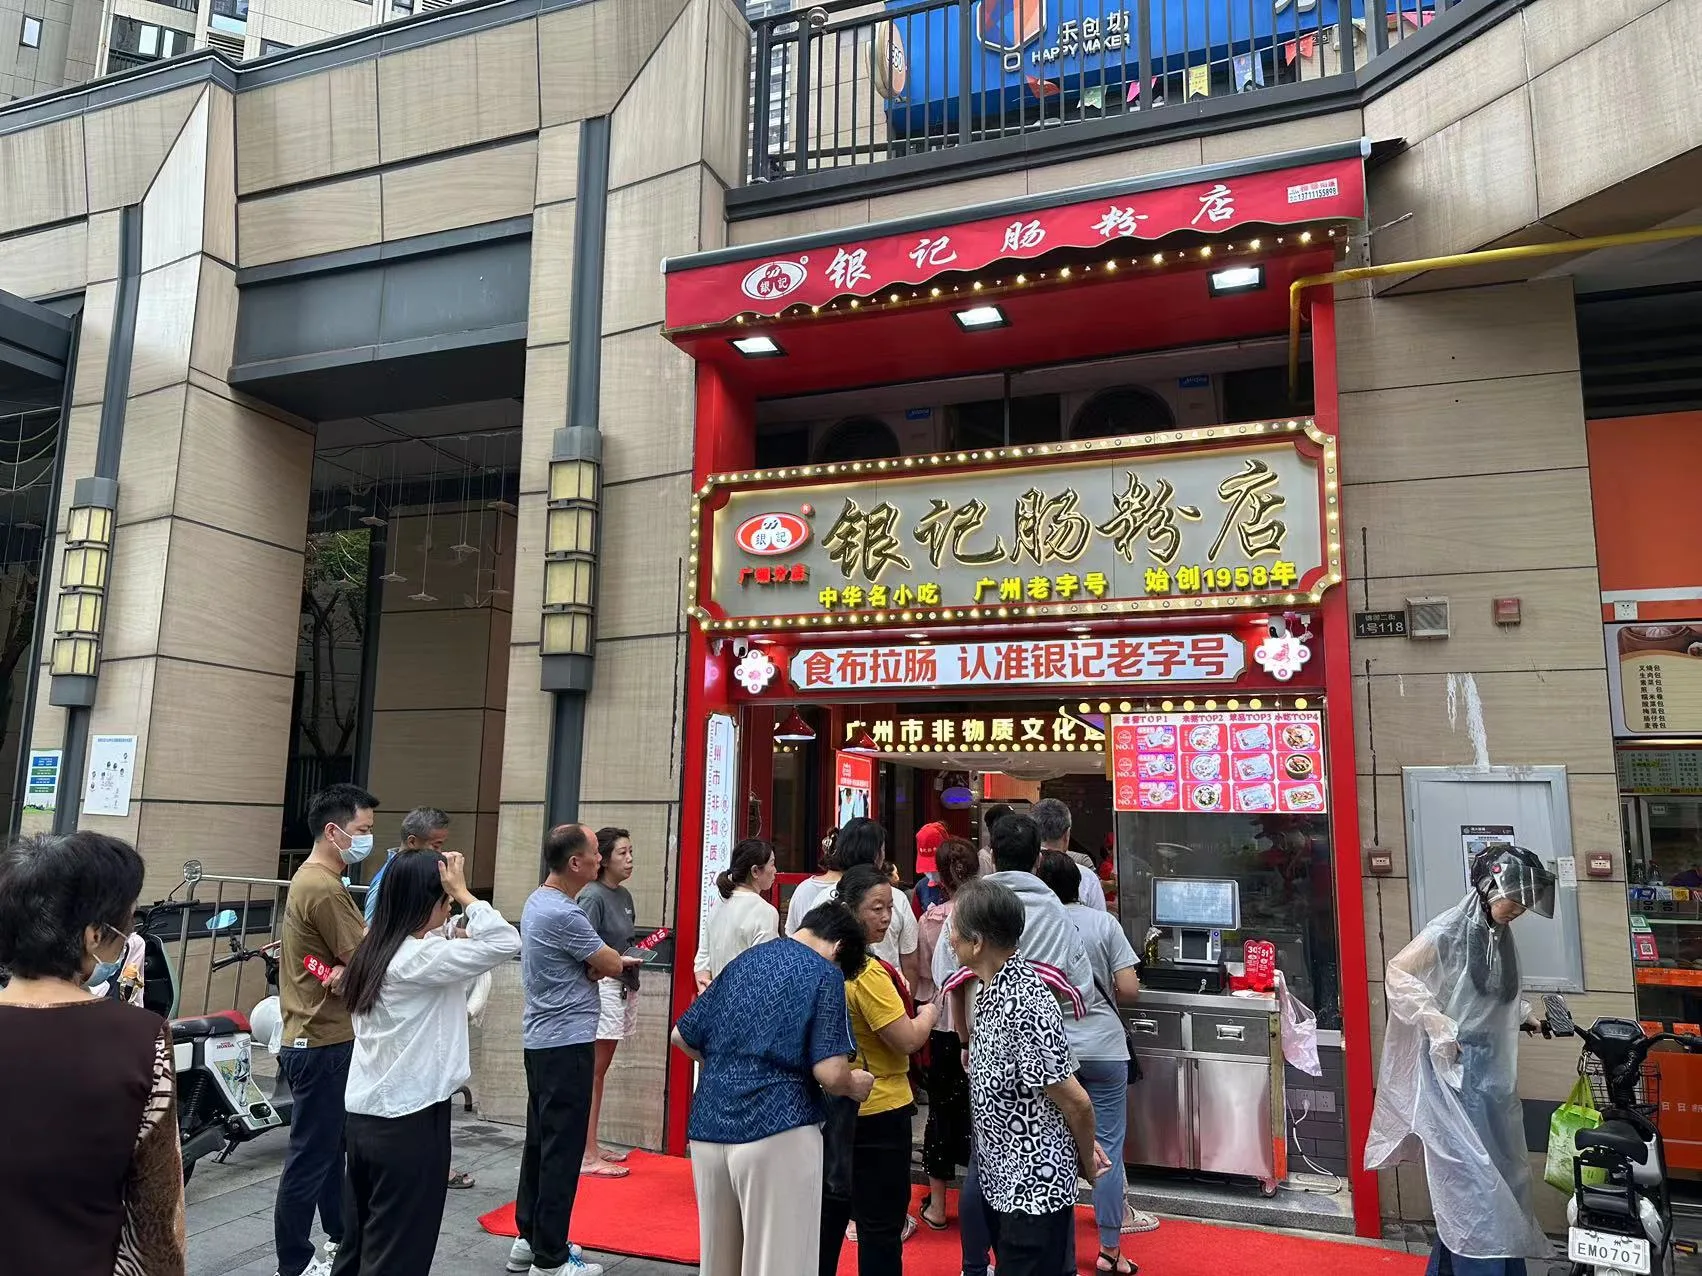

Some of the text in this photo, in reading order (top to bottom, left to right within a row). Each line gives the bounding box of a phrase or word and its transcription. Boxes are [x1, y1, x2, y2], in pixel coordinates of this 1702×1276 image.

[1031, 33, 1130, 64] HAPPY MAKER
[825, 185, 1235, 288] 银记肠粉店
[821, 459, 1286, 581] 银记肠粉店
[974, 572, 1108, 602] 广州老字号
[1144, 561, 1297, 593] 始创1958年
[818, 583, 940, 608] 中华名小吃
[1359, 621, 1404, 634] 1号118
[803, 637, 1228, 686] 食布拉肠 认准银记老字号
[1577, 1242, 1640, 1265] EM0707
